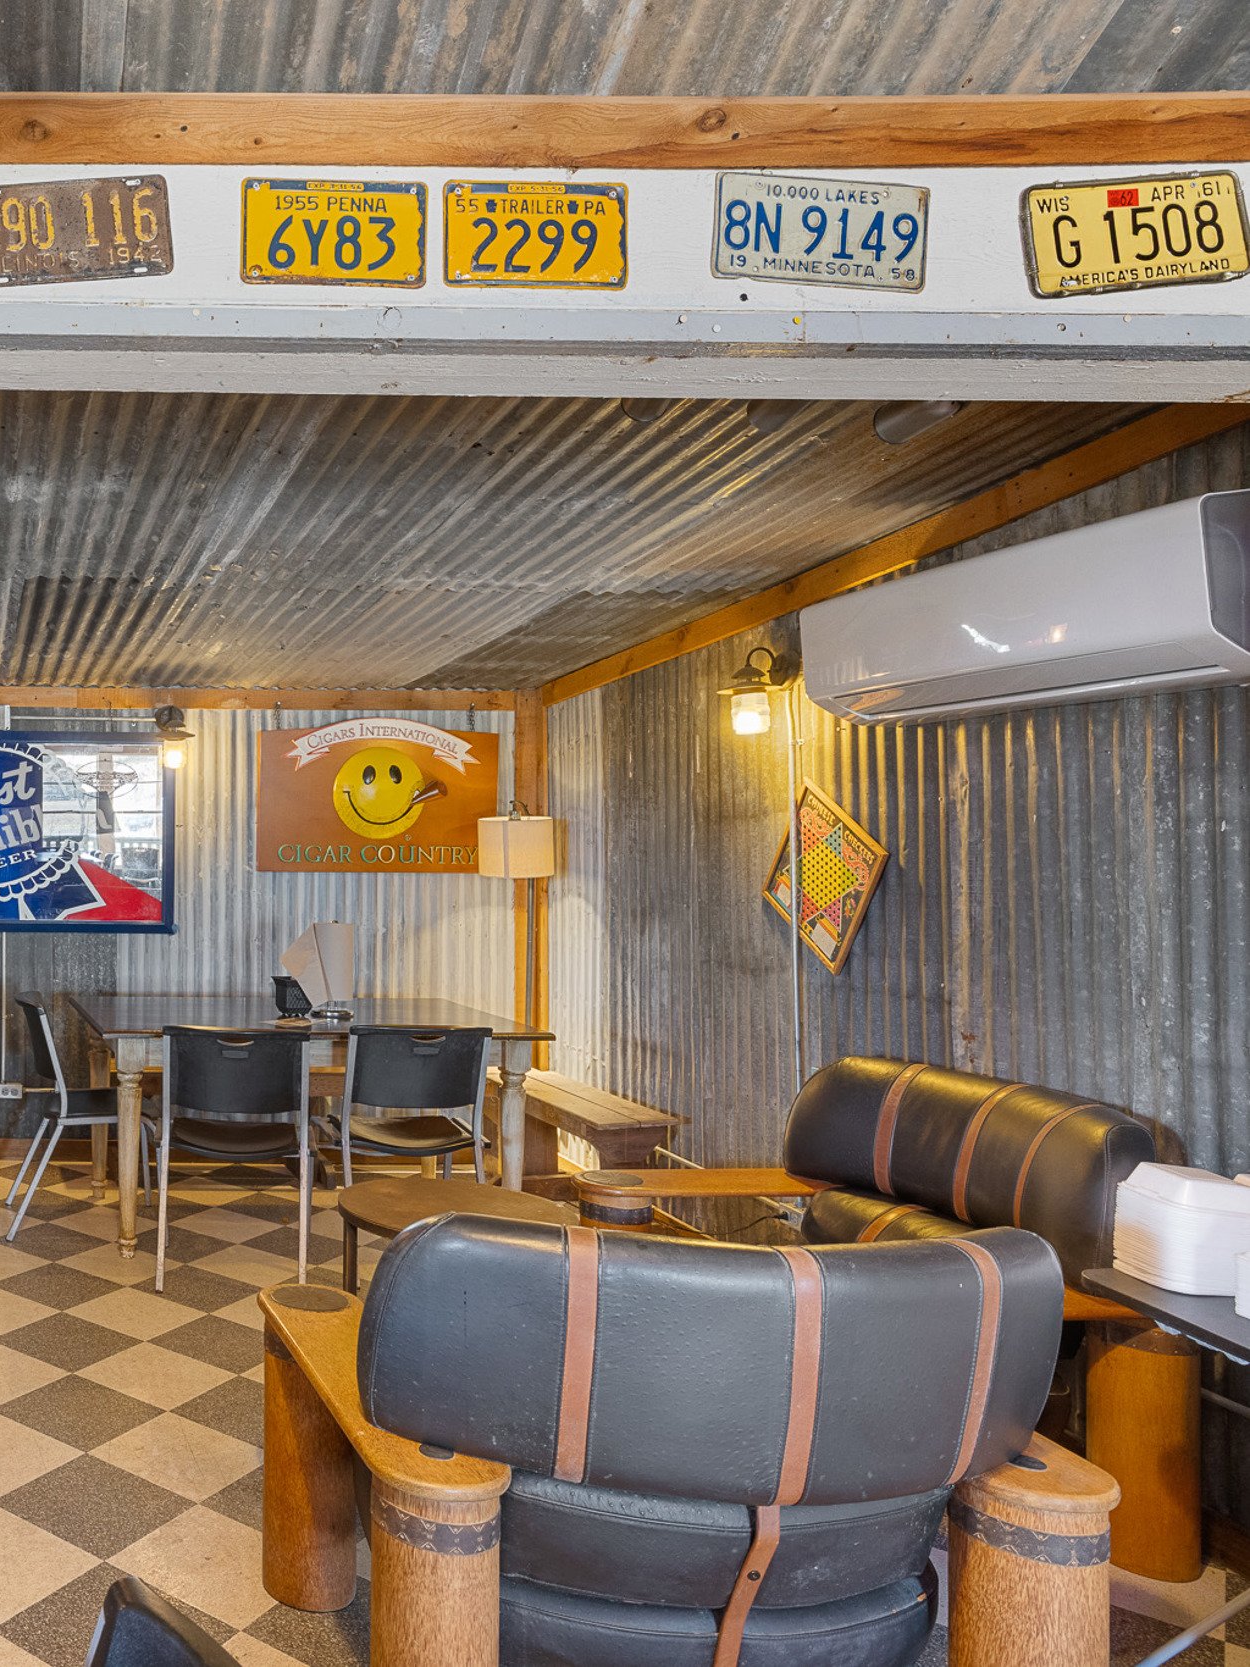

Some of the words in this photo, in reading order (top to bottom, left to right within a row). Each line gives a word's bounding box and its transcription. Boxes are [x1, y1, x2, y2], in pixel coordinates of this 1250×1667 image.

[825, 188, 881, 206] LAKES
[1151, 184, 1185, 202] APR
[275, 195, 319, 212] 1955
[326, 196, 387, 214] PENNA
[454, 197, 480, 214] 55
[499, 198, 564, 215] TRAILER
[584, 199, 607, 216] PA
[1036, 196, 1071, 214] WIS
[81, 187, 158, 248] 116
[723, 199, 783, 255] 8N
[801, 204, 919, 264] 9149
[1052, 214, 1082, 269] G
[1103, 199, 1225, 265] 1508
[267, 214, 397, 272] 6Y83
[470, 217, 599, 274] 2299
[108, 244, 166, 266] 1942
[729, 254, 747, 268] 19
[762, 257, 876, 279] MINNESOTA
[890, 267, 916, 281] 58
[1144, 258, 1231, 280] DAIRYLAND
[277, 844, 352, 865] CIGAR
[360, 844, 479, 865] COUNTRY
